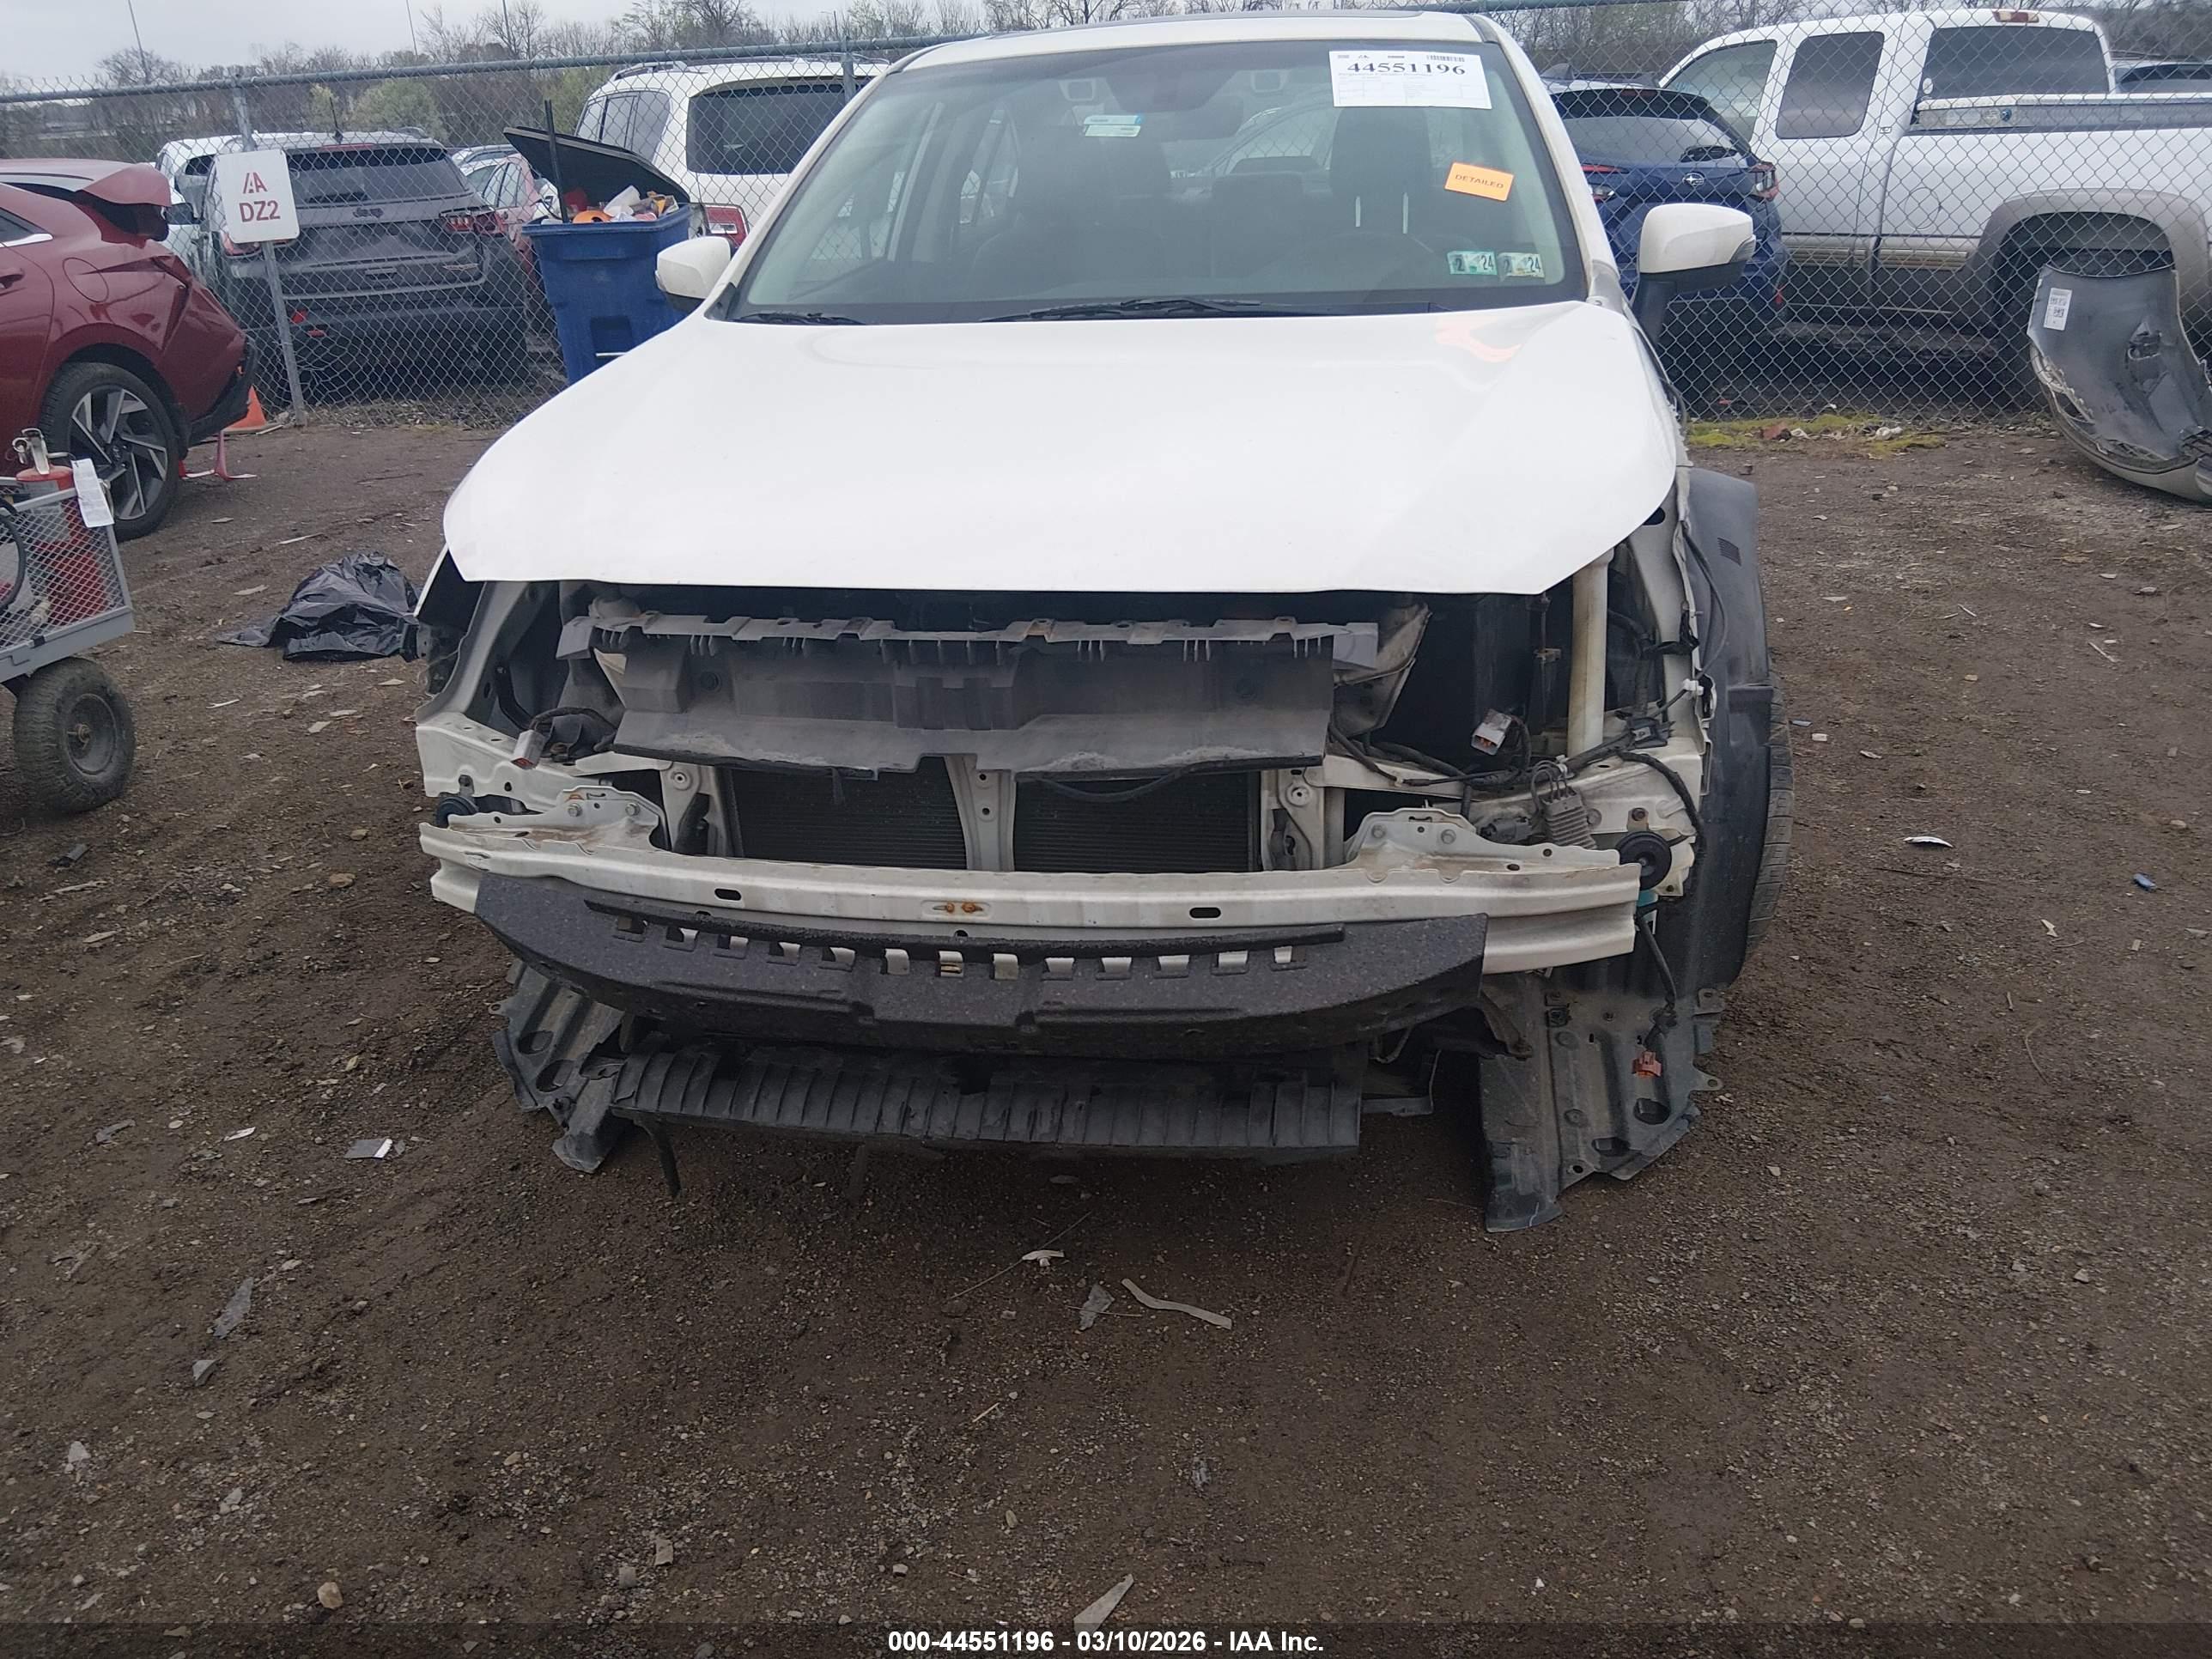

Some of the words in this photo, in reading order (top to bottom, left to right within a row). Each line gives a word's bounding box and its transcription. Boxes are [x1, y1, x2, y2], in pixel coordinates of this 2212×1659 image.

[1347, 62, 1466, 76] 44551196
[1455, 174, 1504, 189] DETAILED
[239, 200, 281, 222] DZ2
[1480, 255, 1494, 270] 24
[1528, 257, 1541, 273] 24
